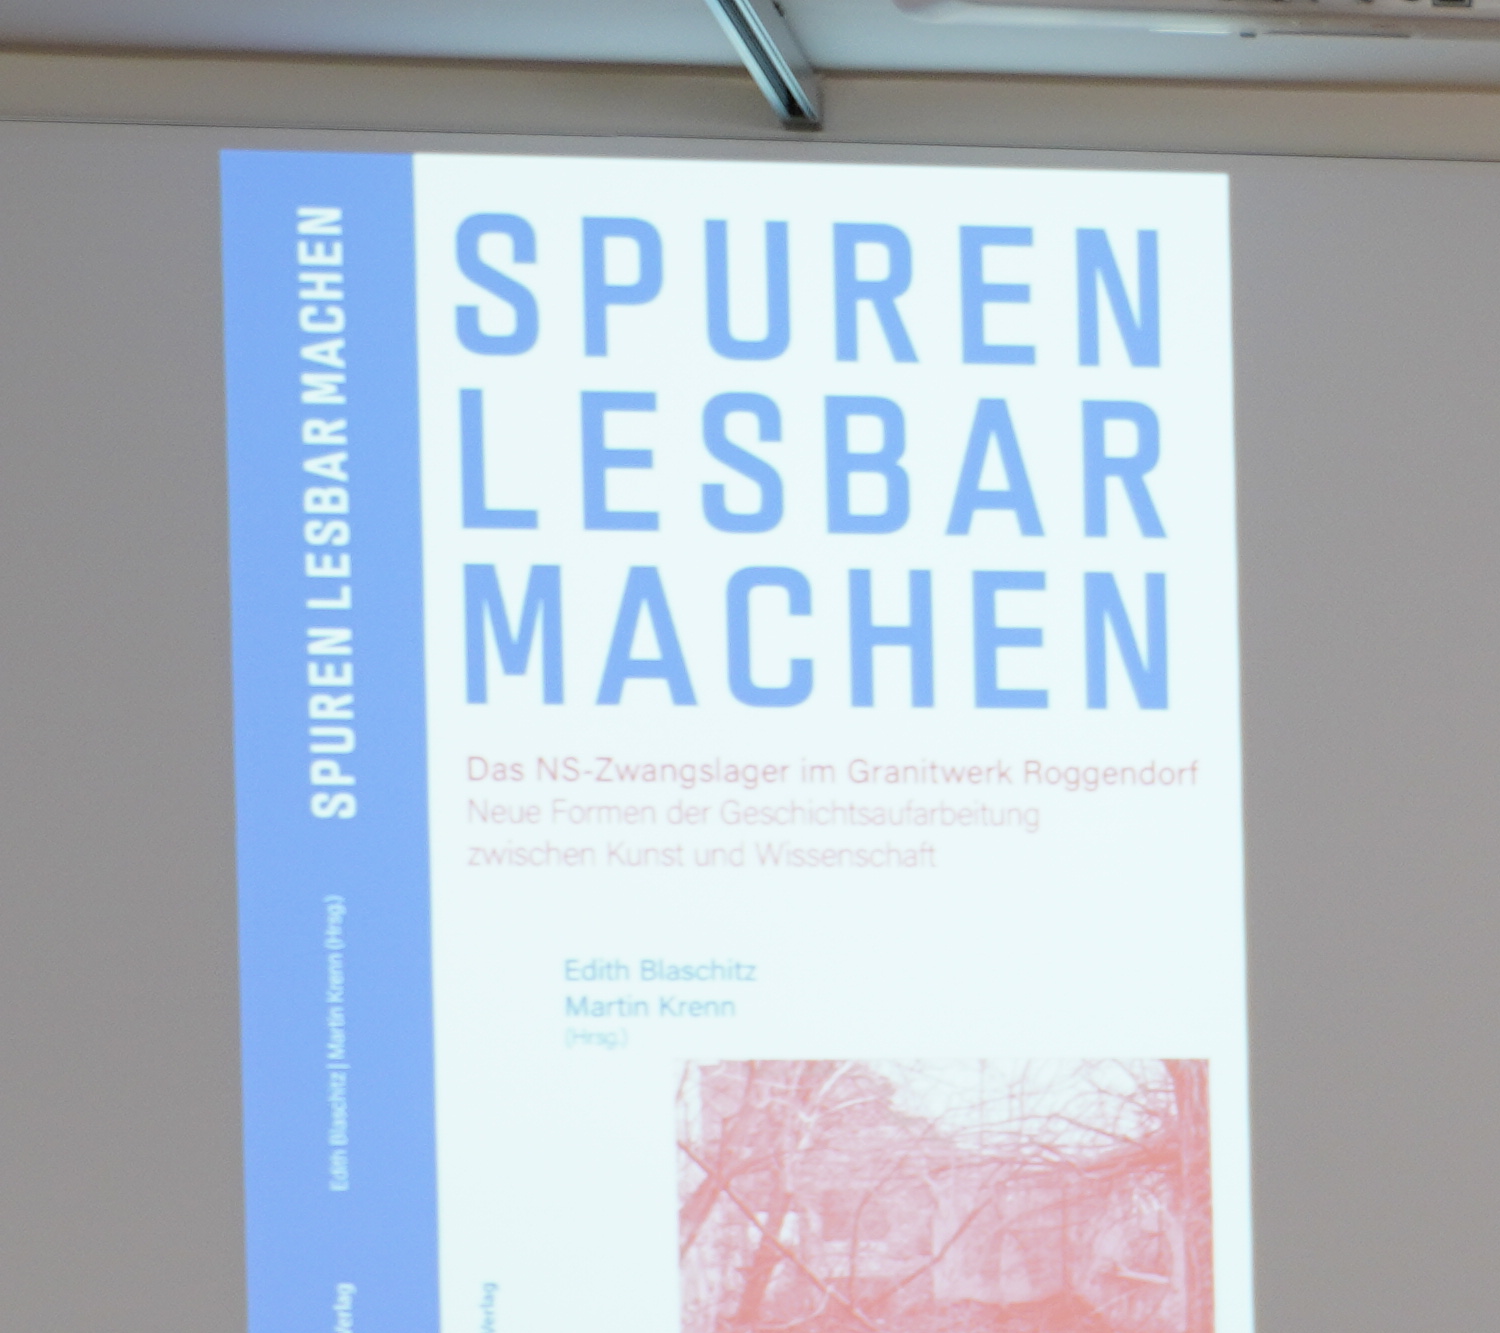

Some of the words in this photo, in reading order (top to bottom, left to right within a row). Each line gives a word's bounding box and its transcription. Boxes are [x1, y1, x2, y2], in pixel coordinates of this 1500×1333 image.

[297, 206, 346, 404] MACHEN
[455, 212, 1161, 367] SPUREN
[459, 388, 1167, 538] LESBAR
[302, 416, 352, 610] LESBAR
[463, 563, 1169, 710] MACHEN
[307, 625, 357, 819] SPUREN
[467, 756, 524, 782] Das
[536, 756, 789, 789] NS-Zwangslager
[800, 757, 836, 783] im
[848, 758, 1012, 784] Granitwerk
[1023, 759, 1199, 791] Roggendorf
[467, 799, 541, 824] Neue
[551, 799, 656, 825] Formen
[667, 799, 711, 825] der
[720, 799, 1040, 833] Geschichtsaufarbeitung
[467, 841, 596, 867] zwischen
[606, 841, 684, 867] Kunst
[694, 842, 744, 867] und
[755, 841, 937, 868] Wissenschaft
[325, 952, 345, 1003] Krenn
[564, 958, 630, 981] Edith
[640, 958, 757, 981] Blaschitz
[326, 1005, 346, 1060] Martin
[565, 995, 649, 1017] Martin
[659, 996, 736, 1017] Krenn
[328, 1071, 348, 1146] Blaschitz
[329, 1149, 349, 1191] Edith
